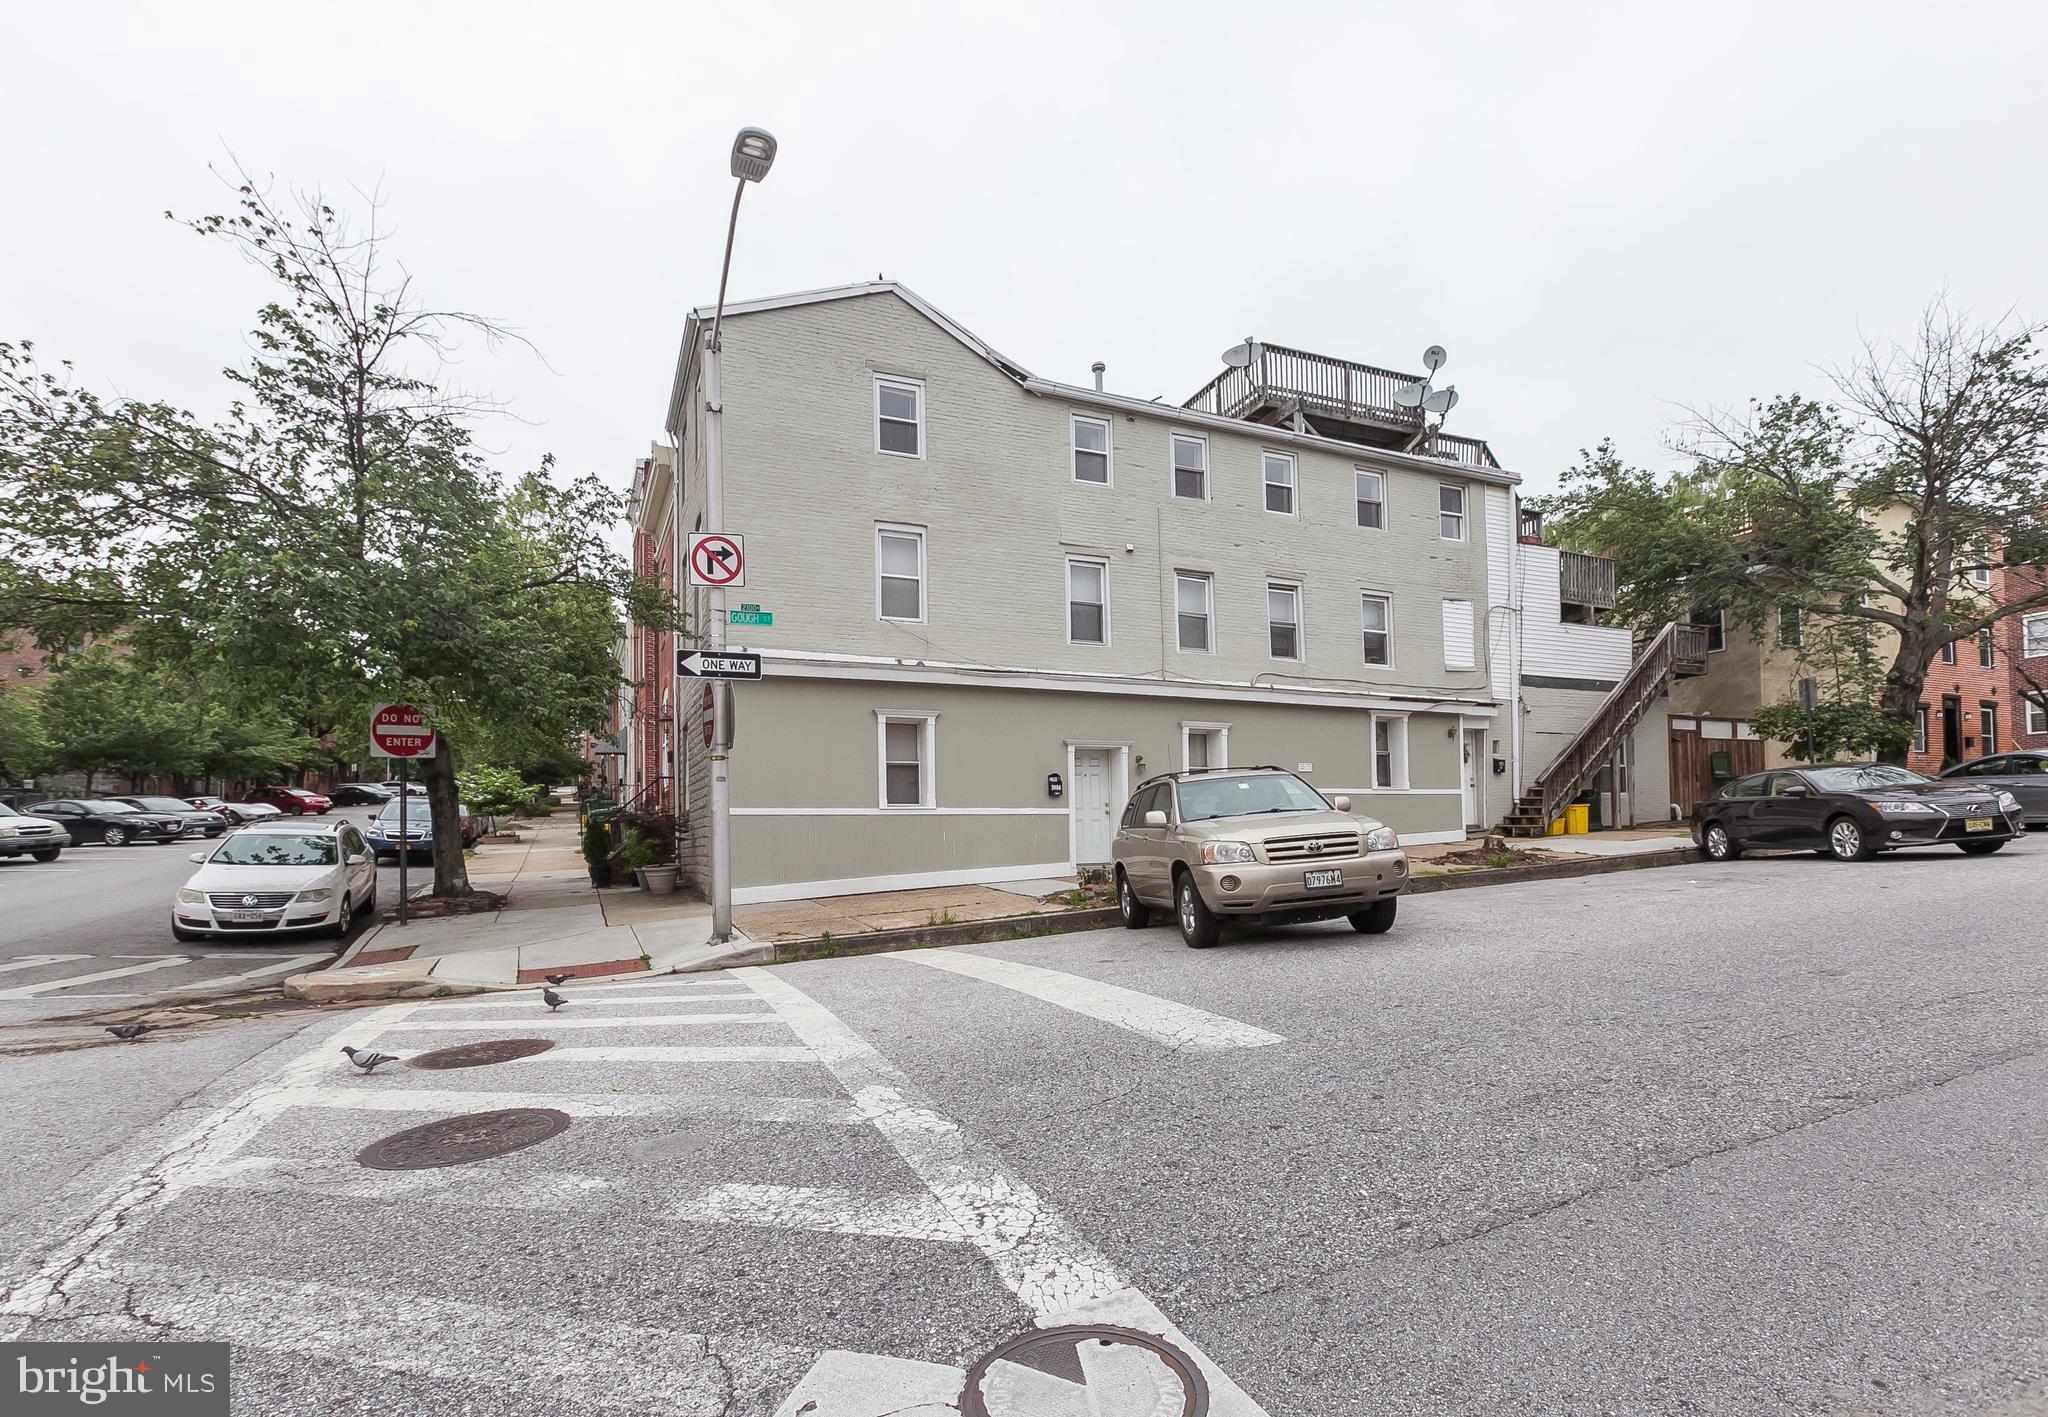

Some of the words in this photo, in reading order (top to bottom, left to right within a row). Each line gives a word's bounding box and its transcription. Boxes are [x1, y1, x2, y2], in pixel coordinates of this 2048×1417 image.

[731, 612, 759, 623] GOUGH
[702, 659, 725, 670] ONE
[729, 660, 752, 671] WAY
[382, 713, 398, 723] DO
[386, 737, 422, 747] ENTER
